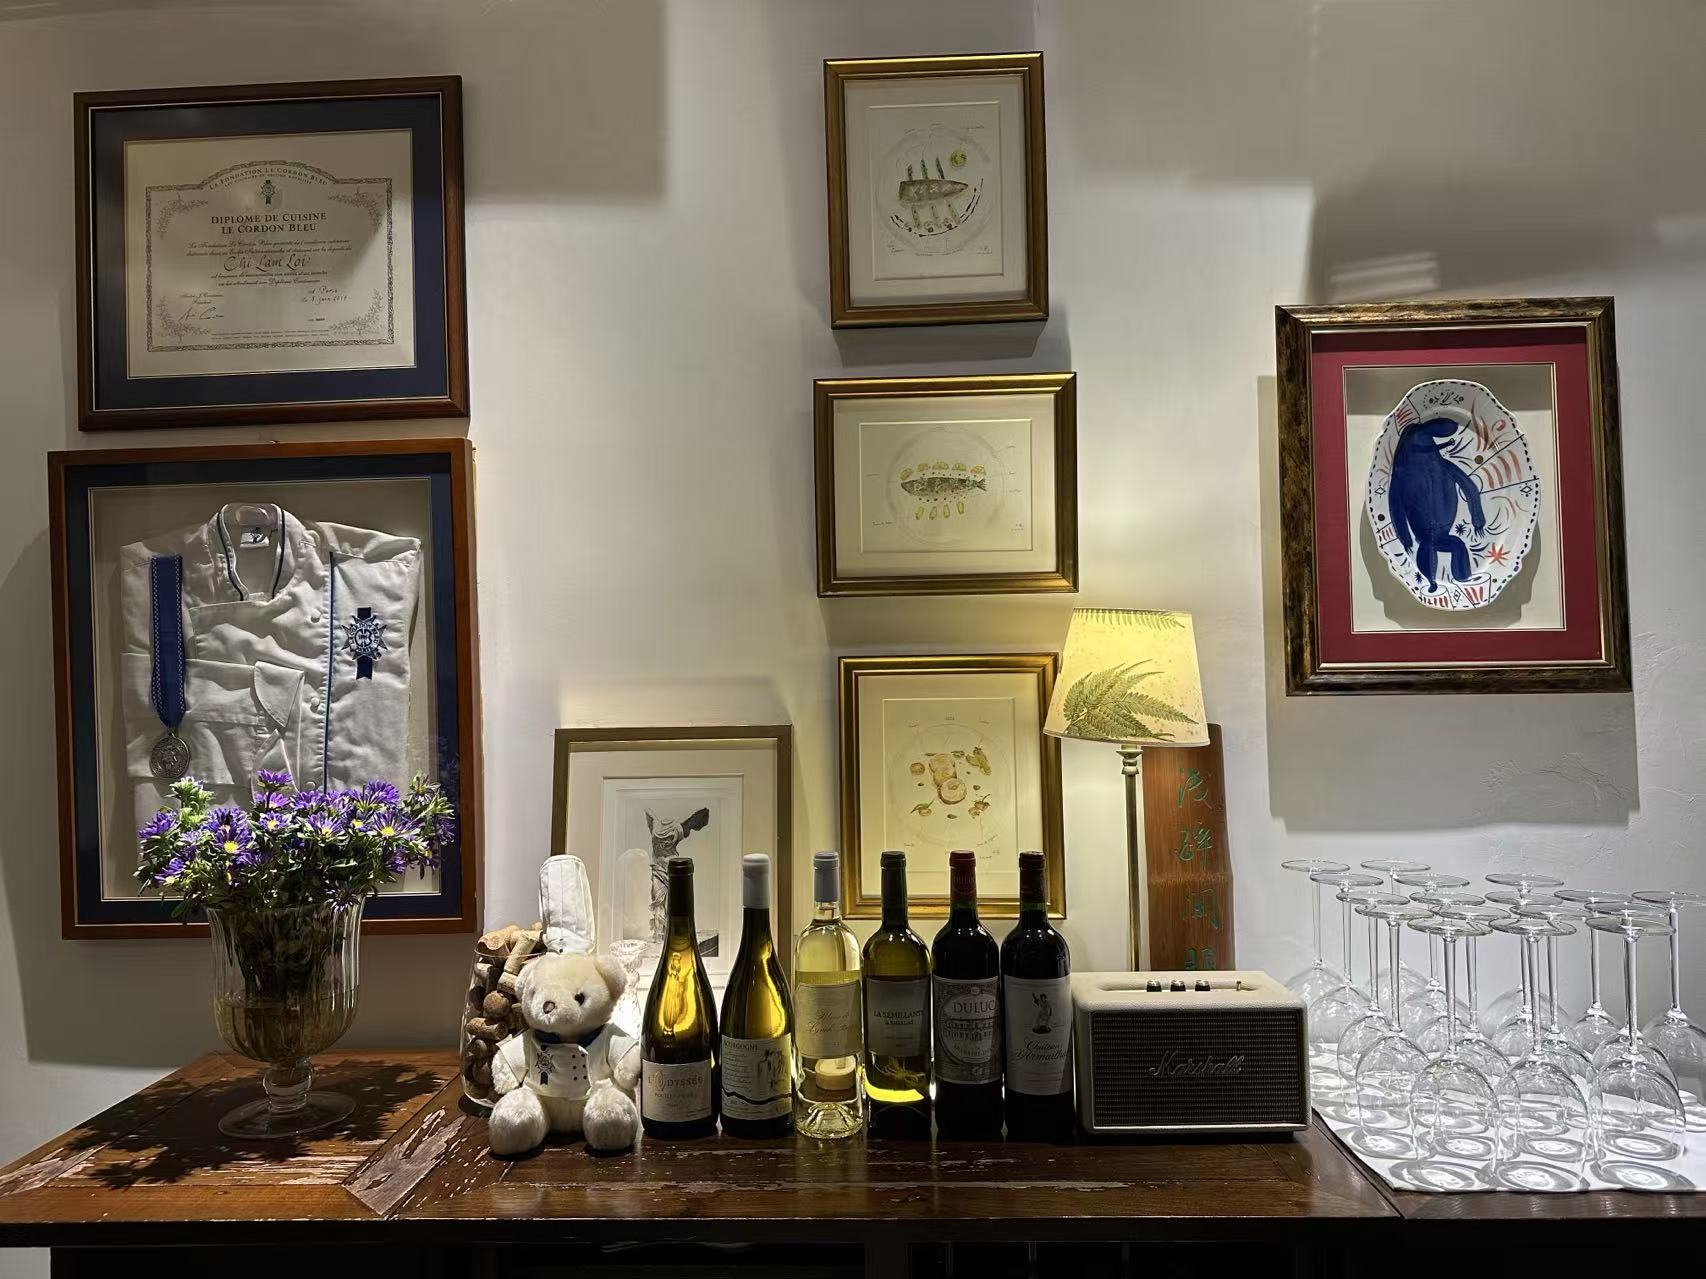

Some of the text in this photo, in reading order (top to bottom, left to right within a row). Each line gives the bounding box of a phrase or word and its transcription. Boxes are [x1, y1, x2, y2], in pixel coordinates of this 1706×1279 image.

[264, 214, 279, 223] DE
[282, 212, 327, 222] CUISINE
[221, 223, 317, 235] LE CORDON BLEU
[1149, 1050, 1245, 1078] Marshall
